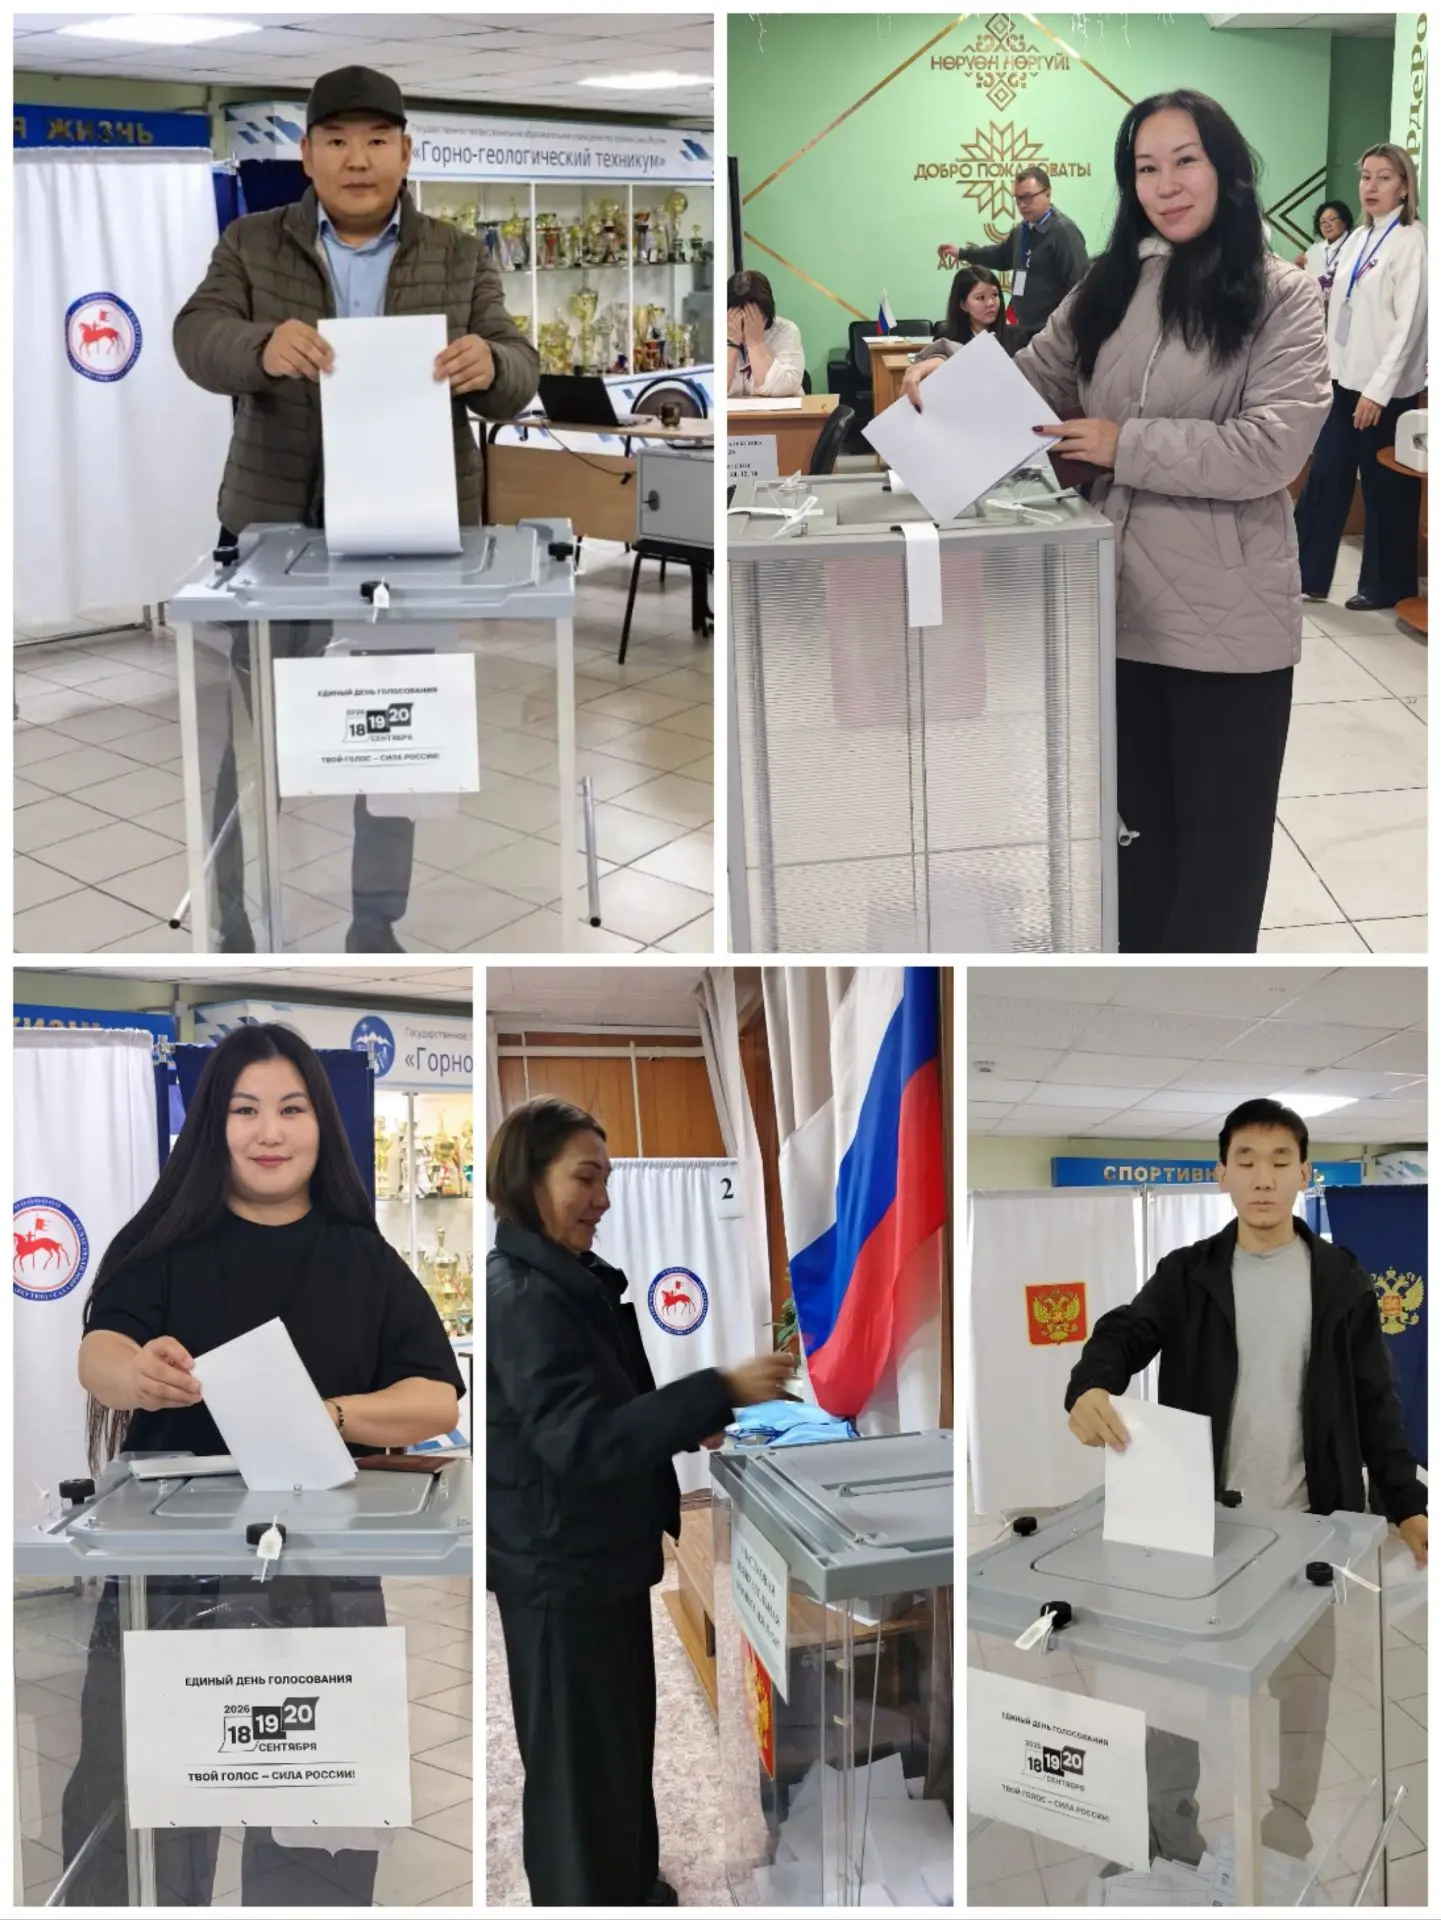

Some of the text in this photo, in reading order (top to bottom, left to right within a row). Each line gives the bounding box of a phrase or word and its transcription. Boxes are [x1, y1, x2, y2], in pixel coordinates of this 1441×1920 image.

[46, 117, 154, 144] ЖИЗНЬ
[413, 140, 667, 174] «Горно-геологический техникум»
[914, 162, 1092, 181] ДОБРО ПОЖАОВАТЬ!
[318, 687, 438, 697] ЕДИНЫЙ ДЕНЬ ГОЛОСОВАНИЯ
[350, 708, 410, 737] 18 19 20
[371, 734, 413, 742] СЕНТЯБРЯ
[321, 755, 344, 764] ТВОЙ
[344, 755, 371, 763] ГОЛОС
[380, 754, 402, 762] СИЛА
[404, 753, 439, 761] РОССИИ!
[1103, 1165, 1217, 1183] СПОРТИВН
[720, 1177, 734, 1200] 2
[185, 1675, 353, 1687] ЕДИНЫЙ ДЕНЬ ГОЛОСОВАНИЯ
[224, 1705, 250, 1714] 2026
[228, 1704, 313, 1744] 18 19 20
[1002, 1711, 1109, 1747] ЕДИНЫЙ ДЕНЬ ГОЛОСОВАНИЯ
[259, 1743, 317, 1752] СЕНТЯБРЯ
[1027, 1751, 1082, 1772] 18 19 20
[188, 1771, 218, 1781] ТВОЙ
[222, 1771, 259, 1781] ГОЛОС
[272, 1770, 302, 1780] СИЛА
[305, 1770, 356, 1780] РОССИИ!
[1046, 1776, 1085, 1792] СЕНТЯБРЯ
[1002, 1783, 1021, 1795] ТВОЙ
[1022, 1791, 1047, 1803] ГОЛОС
[1054, 1799, 1075, 1812] СИЛА
[1075, 1806, 1110, 1823] РОССИИ!
